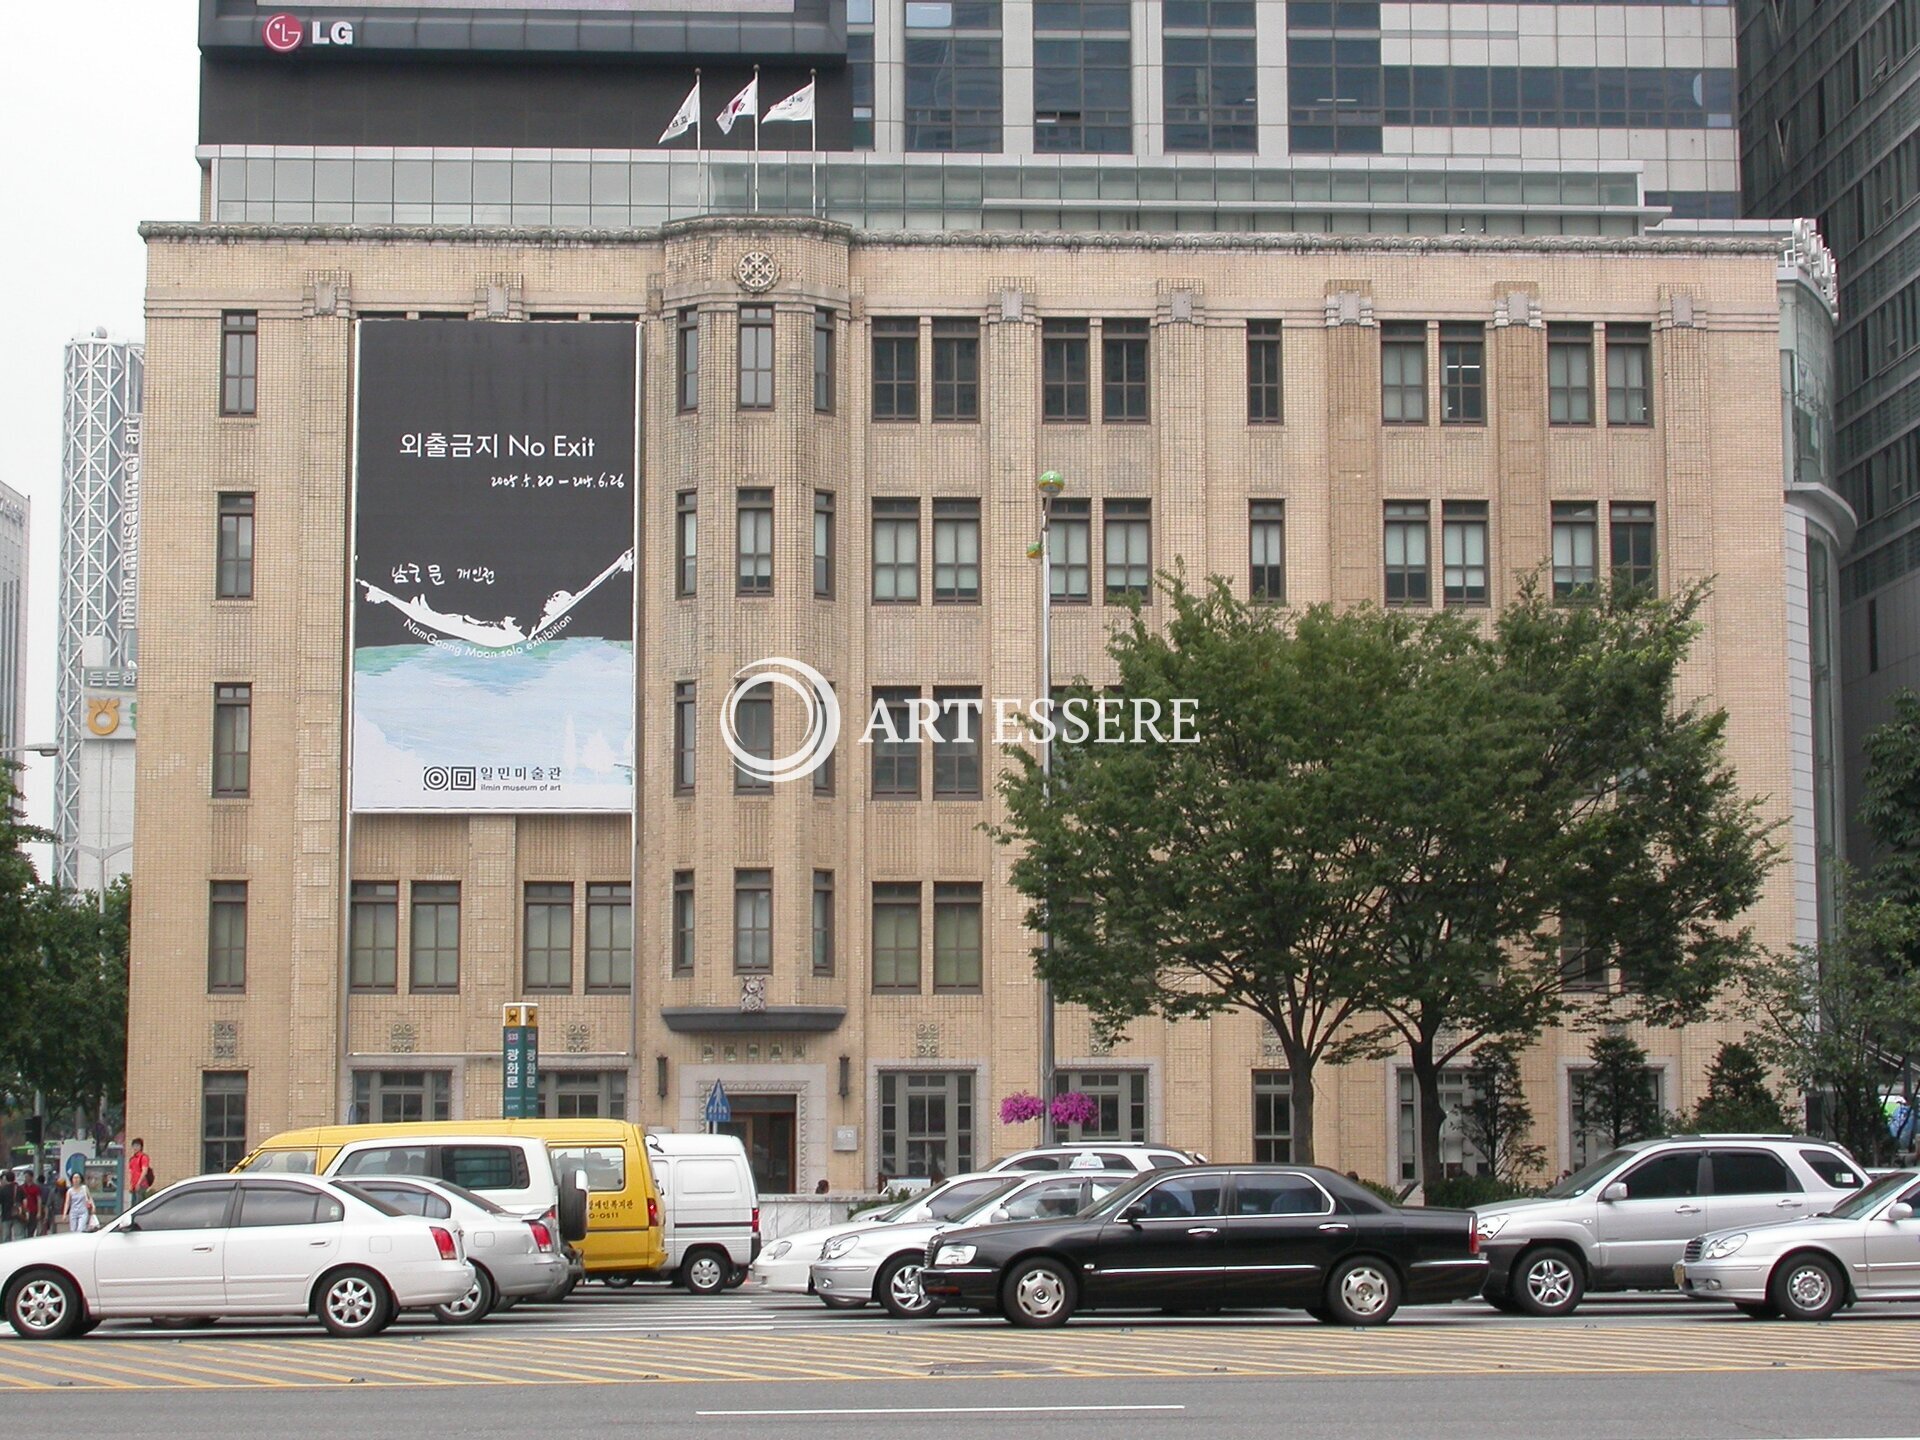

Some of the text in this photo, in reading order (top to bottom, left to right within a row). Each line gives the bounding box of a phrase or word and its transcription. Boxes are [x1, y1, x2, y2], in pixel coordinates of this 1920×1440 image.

[312, 21, 353, 45] LG
[400, 432, 595, 458] 외출금지 No Exit
[119, 417, 140, 629] ilmin museum of art
[403, 615, 572, 658] NamGoong Moon solo exhibition
[88, 671, 137, 687] 든든한
[480, 766, 562, 781] 일민미술관
[540, 783, 548, 791] of
[507, 1048, 519, 1088] 광화문
